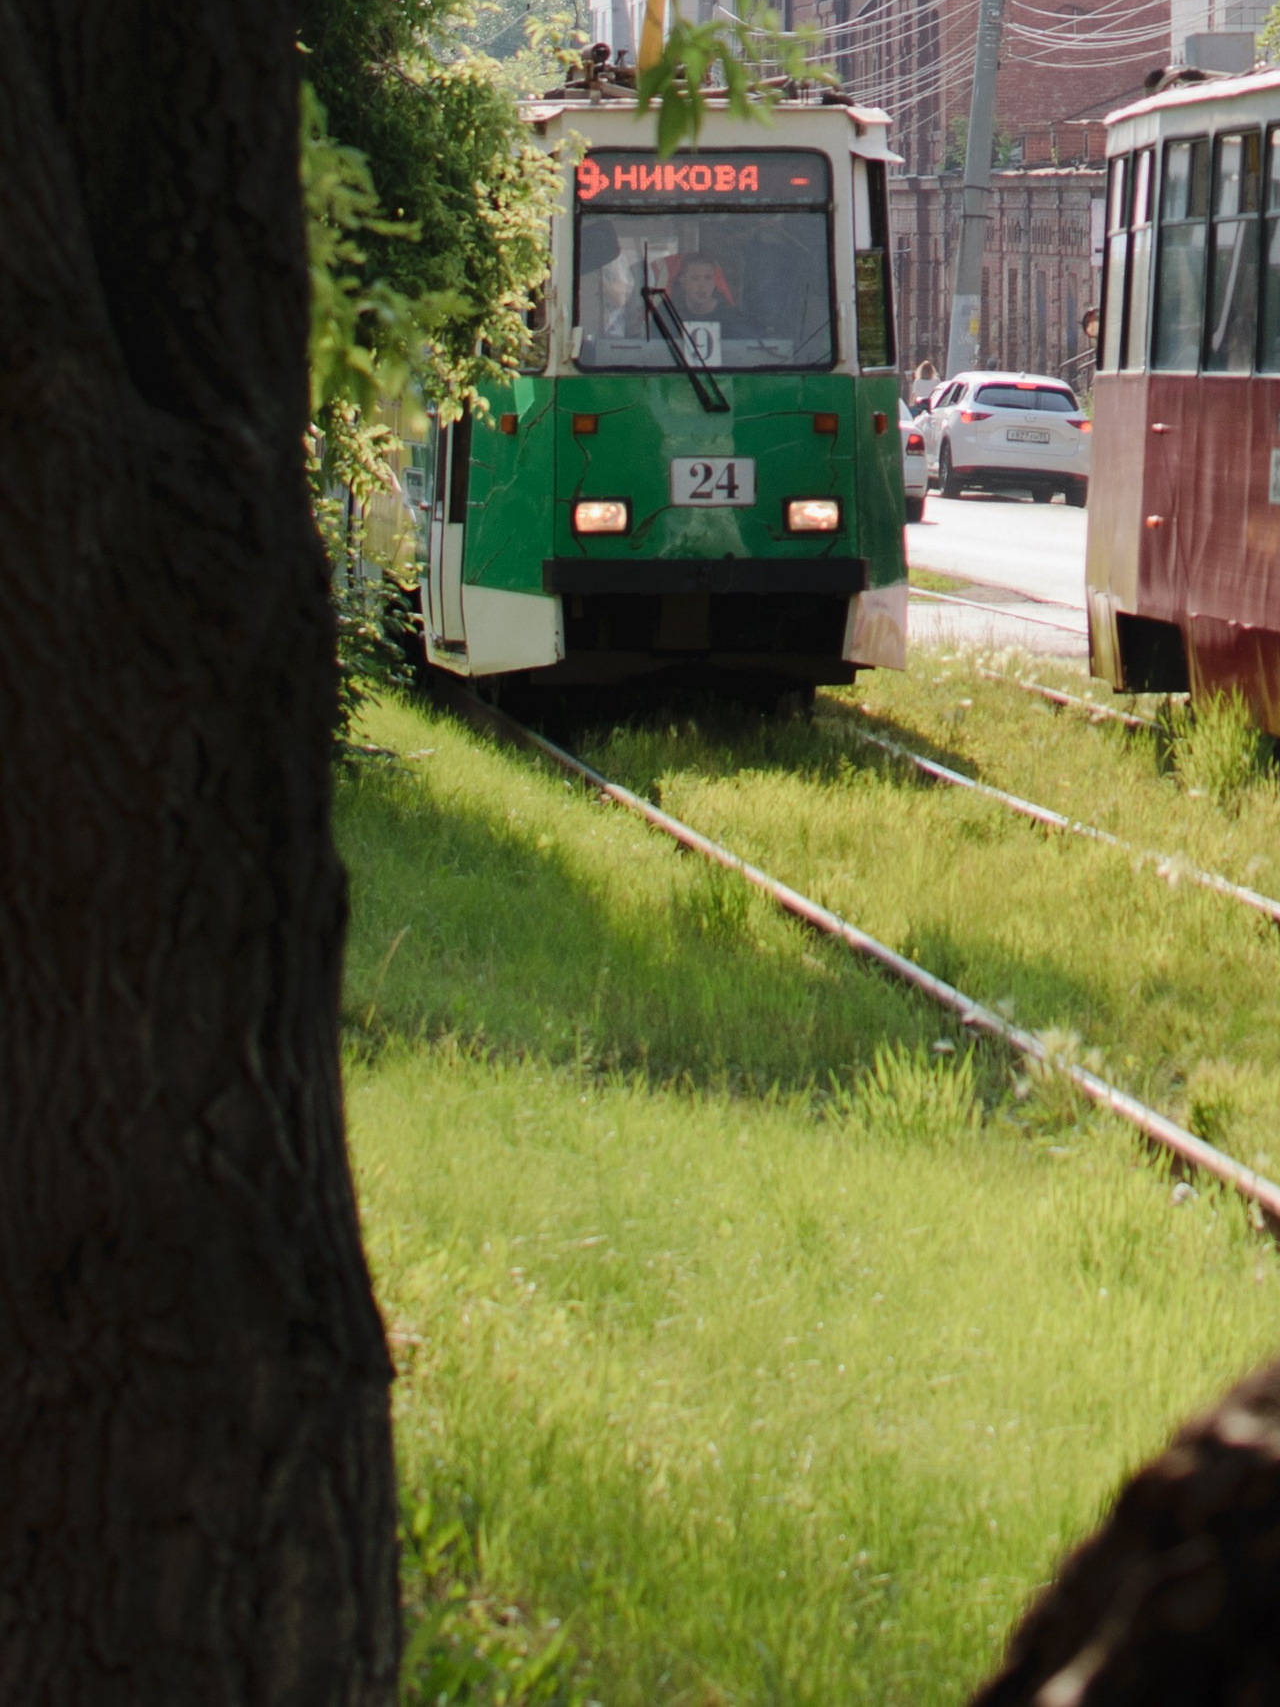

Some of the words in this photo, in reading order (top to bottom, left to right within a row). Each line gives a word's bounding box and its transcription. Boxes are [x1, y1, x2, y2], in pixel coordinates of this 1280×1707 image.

[614, 164, 759, 192] НИКОВА
[690, 327, 714, 361] 9
[689, 462, 740, 500] 24
